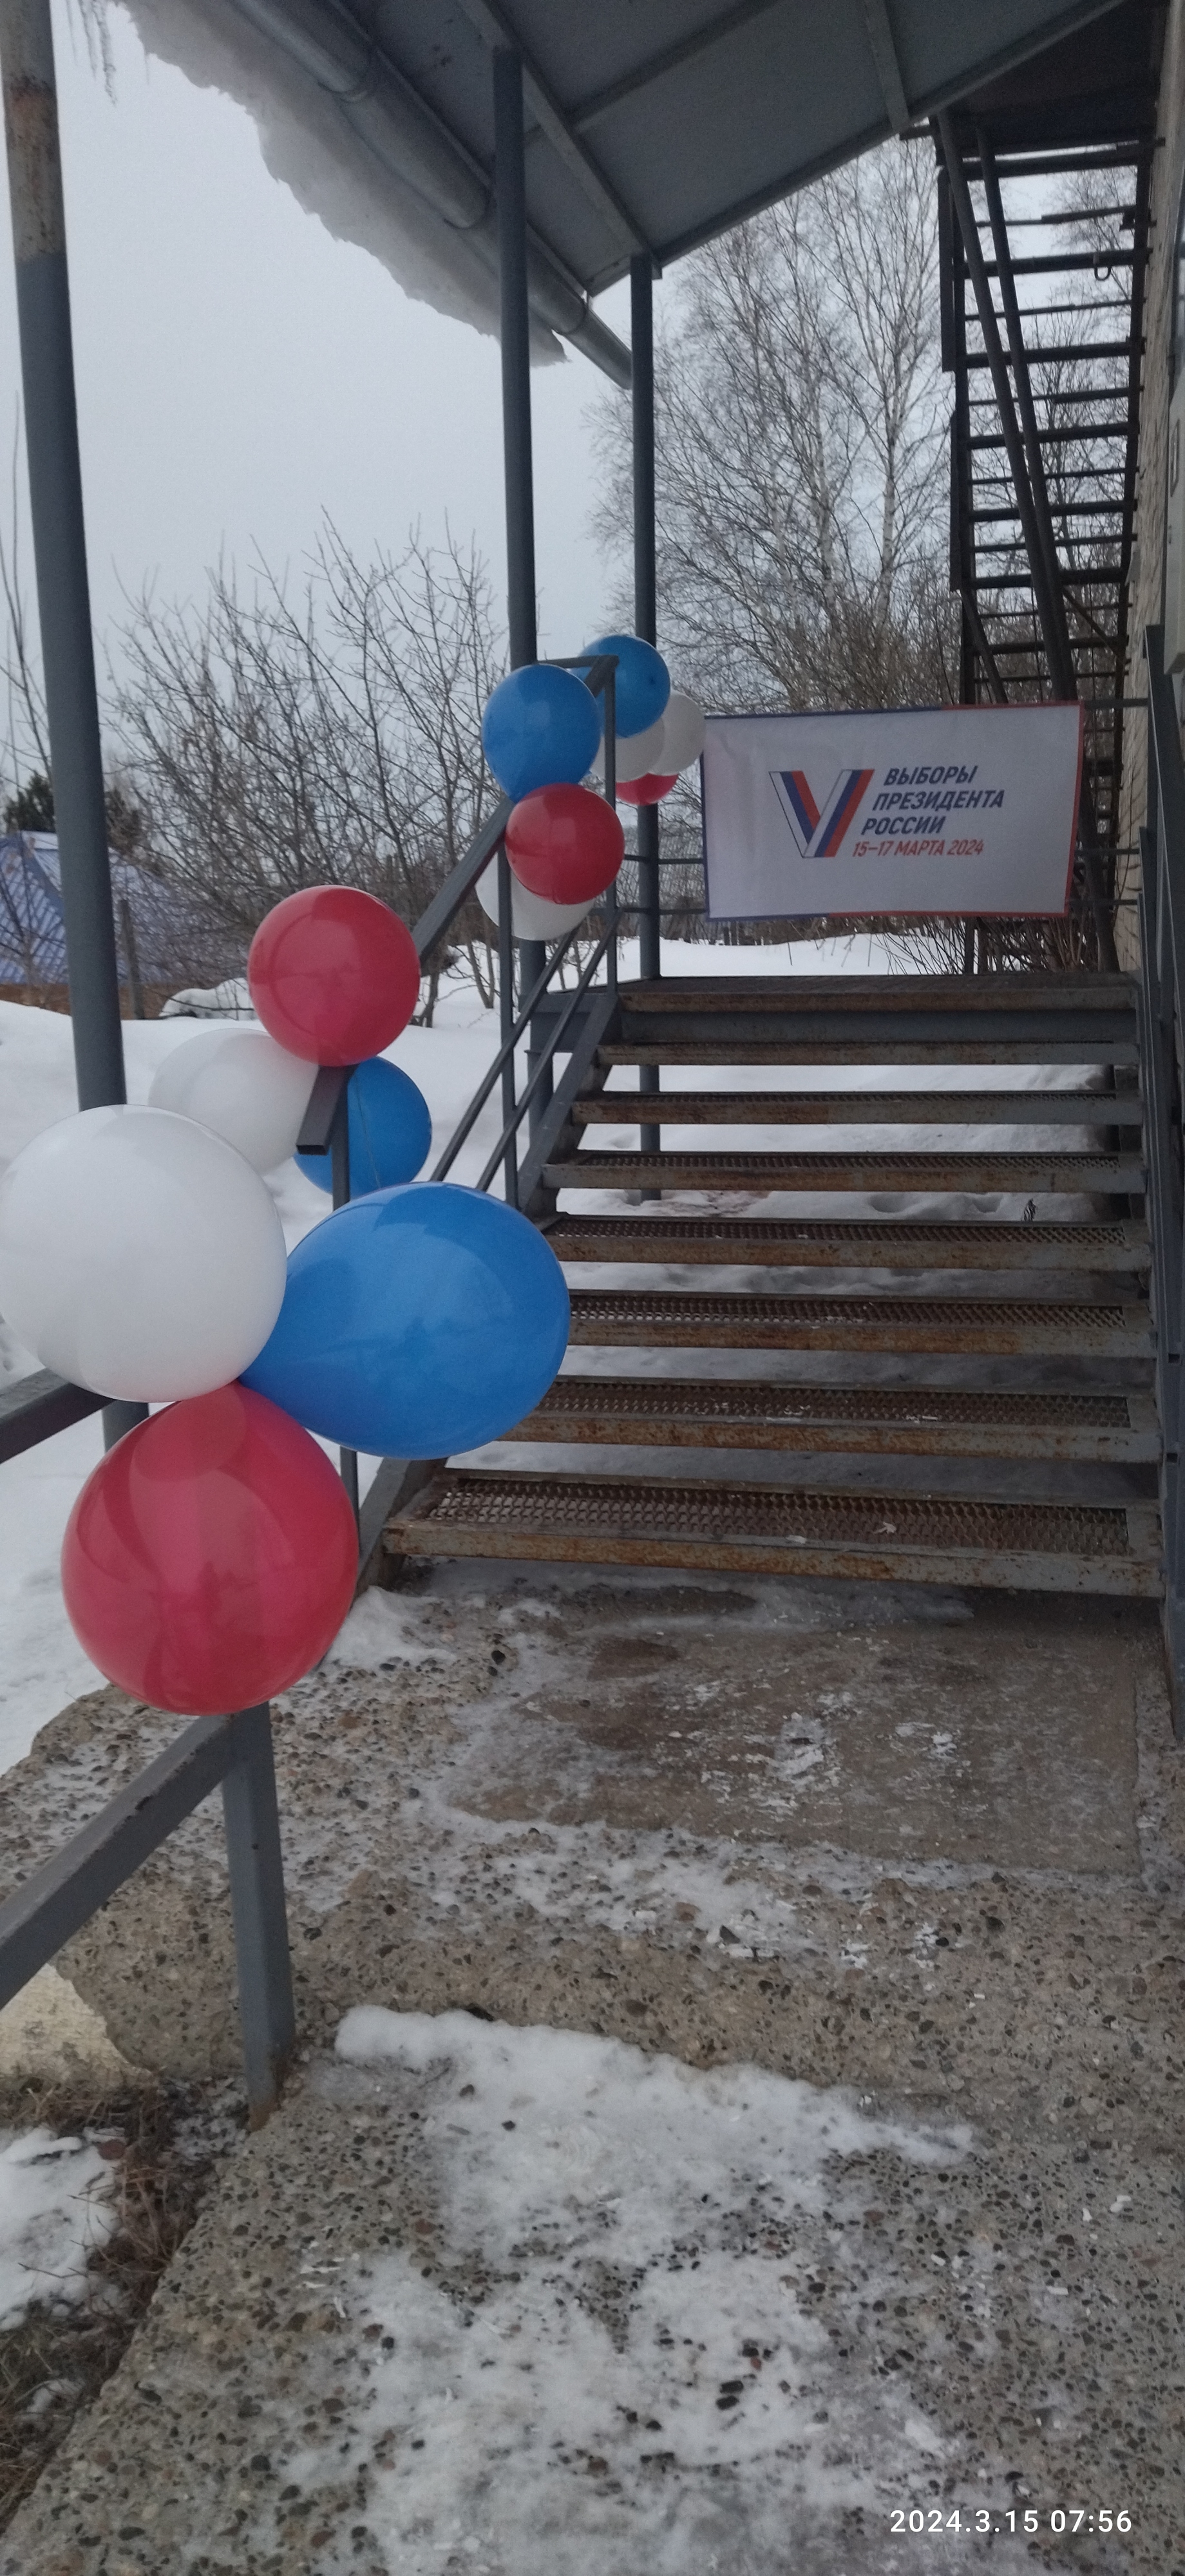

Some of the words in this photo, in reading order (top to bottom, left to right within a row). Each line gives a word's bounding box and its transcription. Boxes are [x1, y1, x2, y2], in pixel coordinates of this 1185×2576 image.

[883, 765, 978, 786] ВЫБОРЫ
[872, 790, 1005, 811] ПРЕЗИДЕНТА
[860, 815, 946, 836] РОССИИ
[896, 840, 944, 856] МАРТА
[947, 838, 984, 855] 2024
